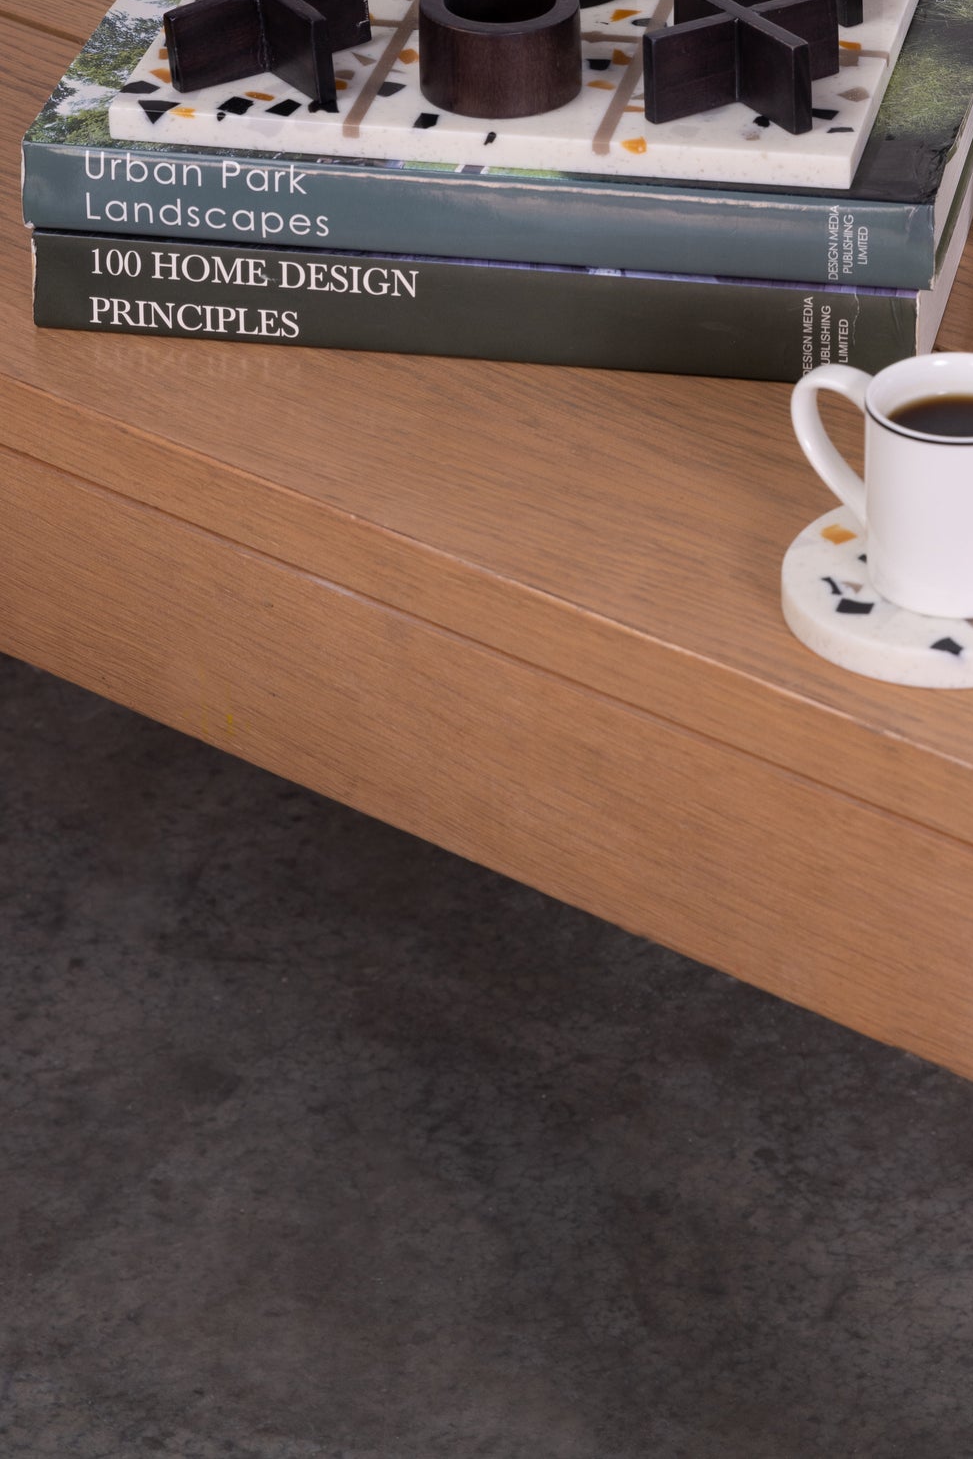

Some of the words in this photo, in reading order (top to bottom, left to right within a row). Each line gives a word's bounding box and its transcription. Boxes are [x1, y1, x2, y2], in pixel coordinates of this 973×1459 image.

[85, 150, 202, 187] Urban
[222, 160, 307, 195] Park
[85, 192, 330, 238] Landscapes
[828, 205, 839, 240] MEDIA
[828, 242, 839, 280] DESIGN
[843, 214, 854, 274] PUBLISHING
[857, 226, 868, 265] LIMITED
[91, 248, 141, 278] 100
[151, 252, 269, 287] HOME
[279, 261, 419, 298] DESIGN
[90, 297, 300, 339] PRINCIPLES
[803, 297, 814, 333] MEDIA
[820, 305, 832, 366] UBLISHING
[838, 318, 849, 363] LIMITED
